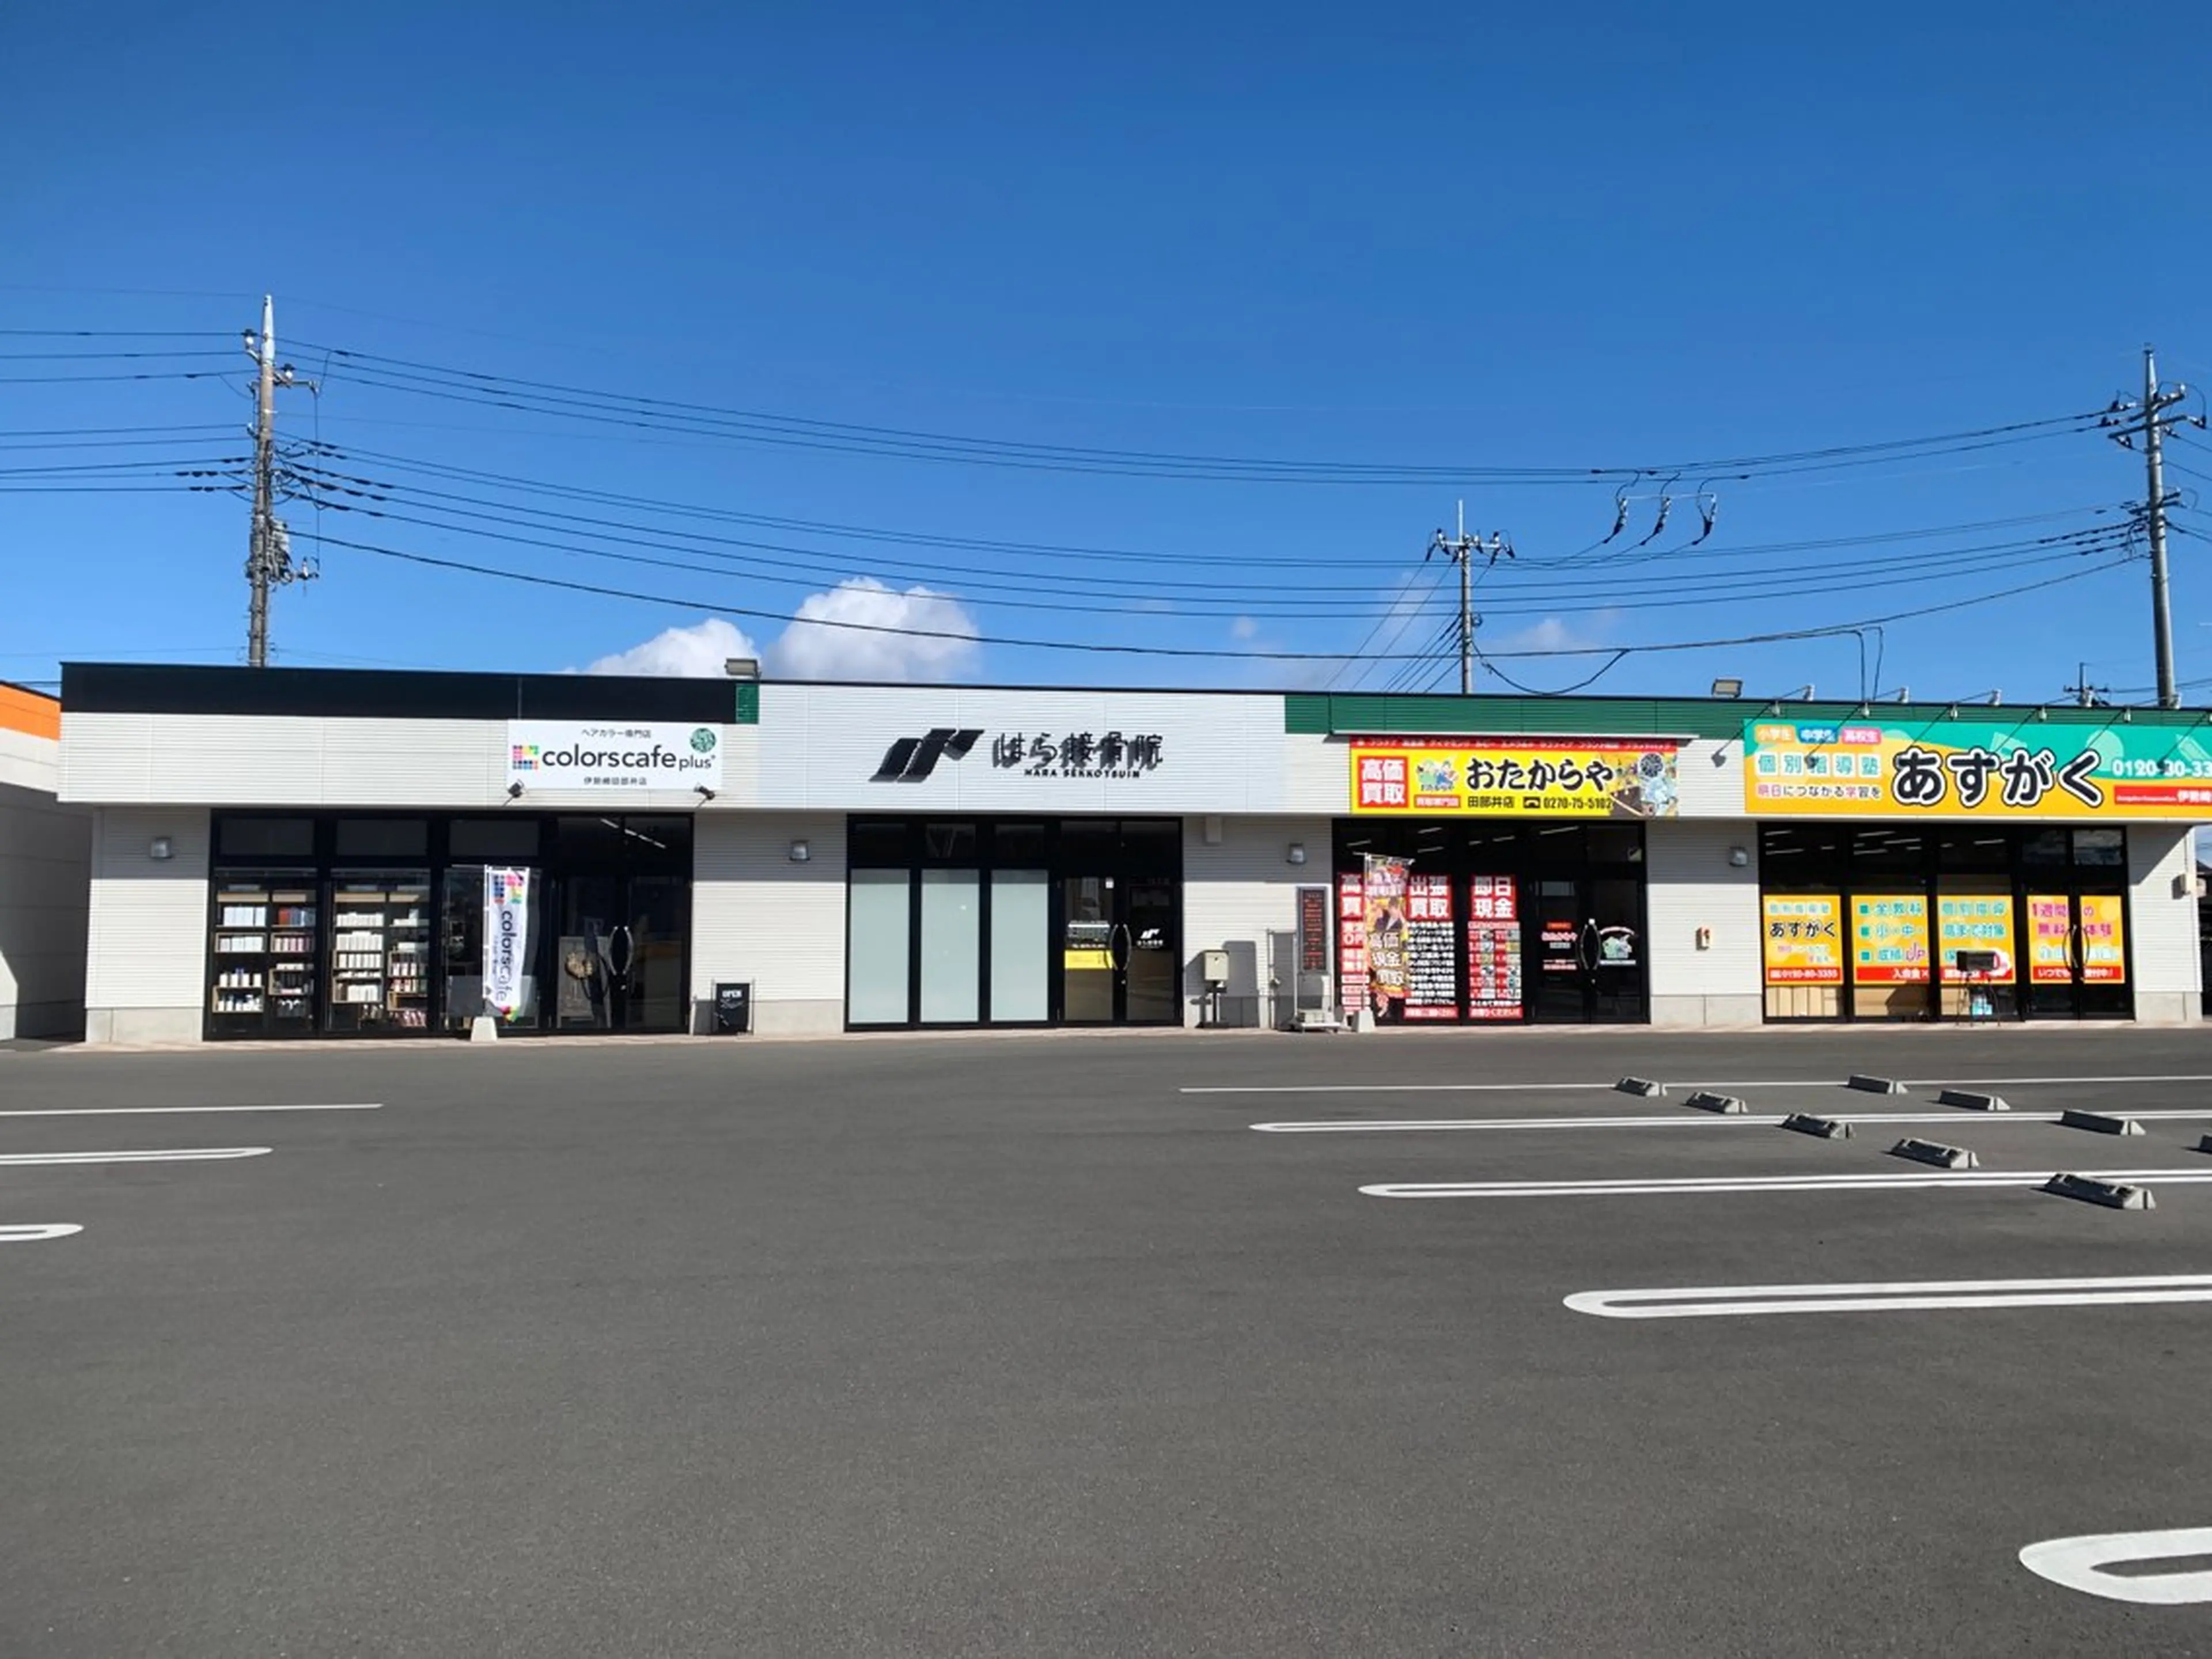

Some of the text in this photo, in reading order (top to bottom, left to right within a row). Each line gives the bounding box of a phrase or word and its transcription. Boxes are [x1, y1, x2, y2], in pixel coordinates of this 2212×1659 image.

[1759, 728, 1791, 741] 小学生
[542, 744, 676, 768] colorscafe
[994, 732, 1164, 765] はら接骨院
[1361, 758, 1405, 781] 高価
[1466, 757, 1613, 791] おたからや
[1893, 748, 2102, 806] あすがく
[1361, 782, 1406, 805] 買取
[1468, 796, 1515, 808] 田部井店
[1758, 785, 1880, 798] 明日につながる学習を
[1409, 876, 1448, 896] 出張
[1410, 897, 1448, 918] 買取
[1474, 897, 1512, 918] 現金
[1770, 922, 1836, 937] あすがく
[496, 910, 517, 1002] colorscafe
